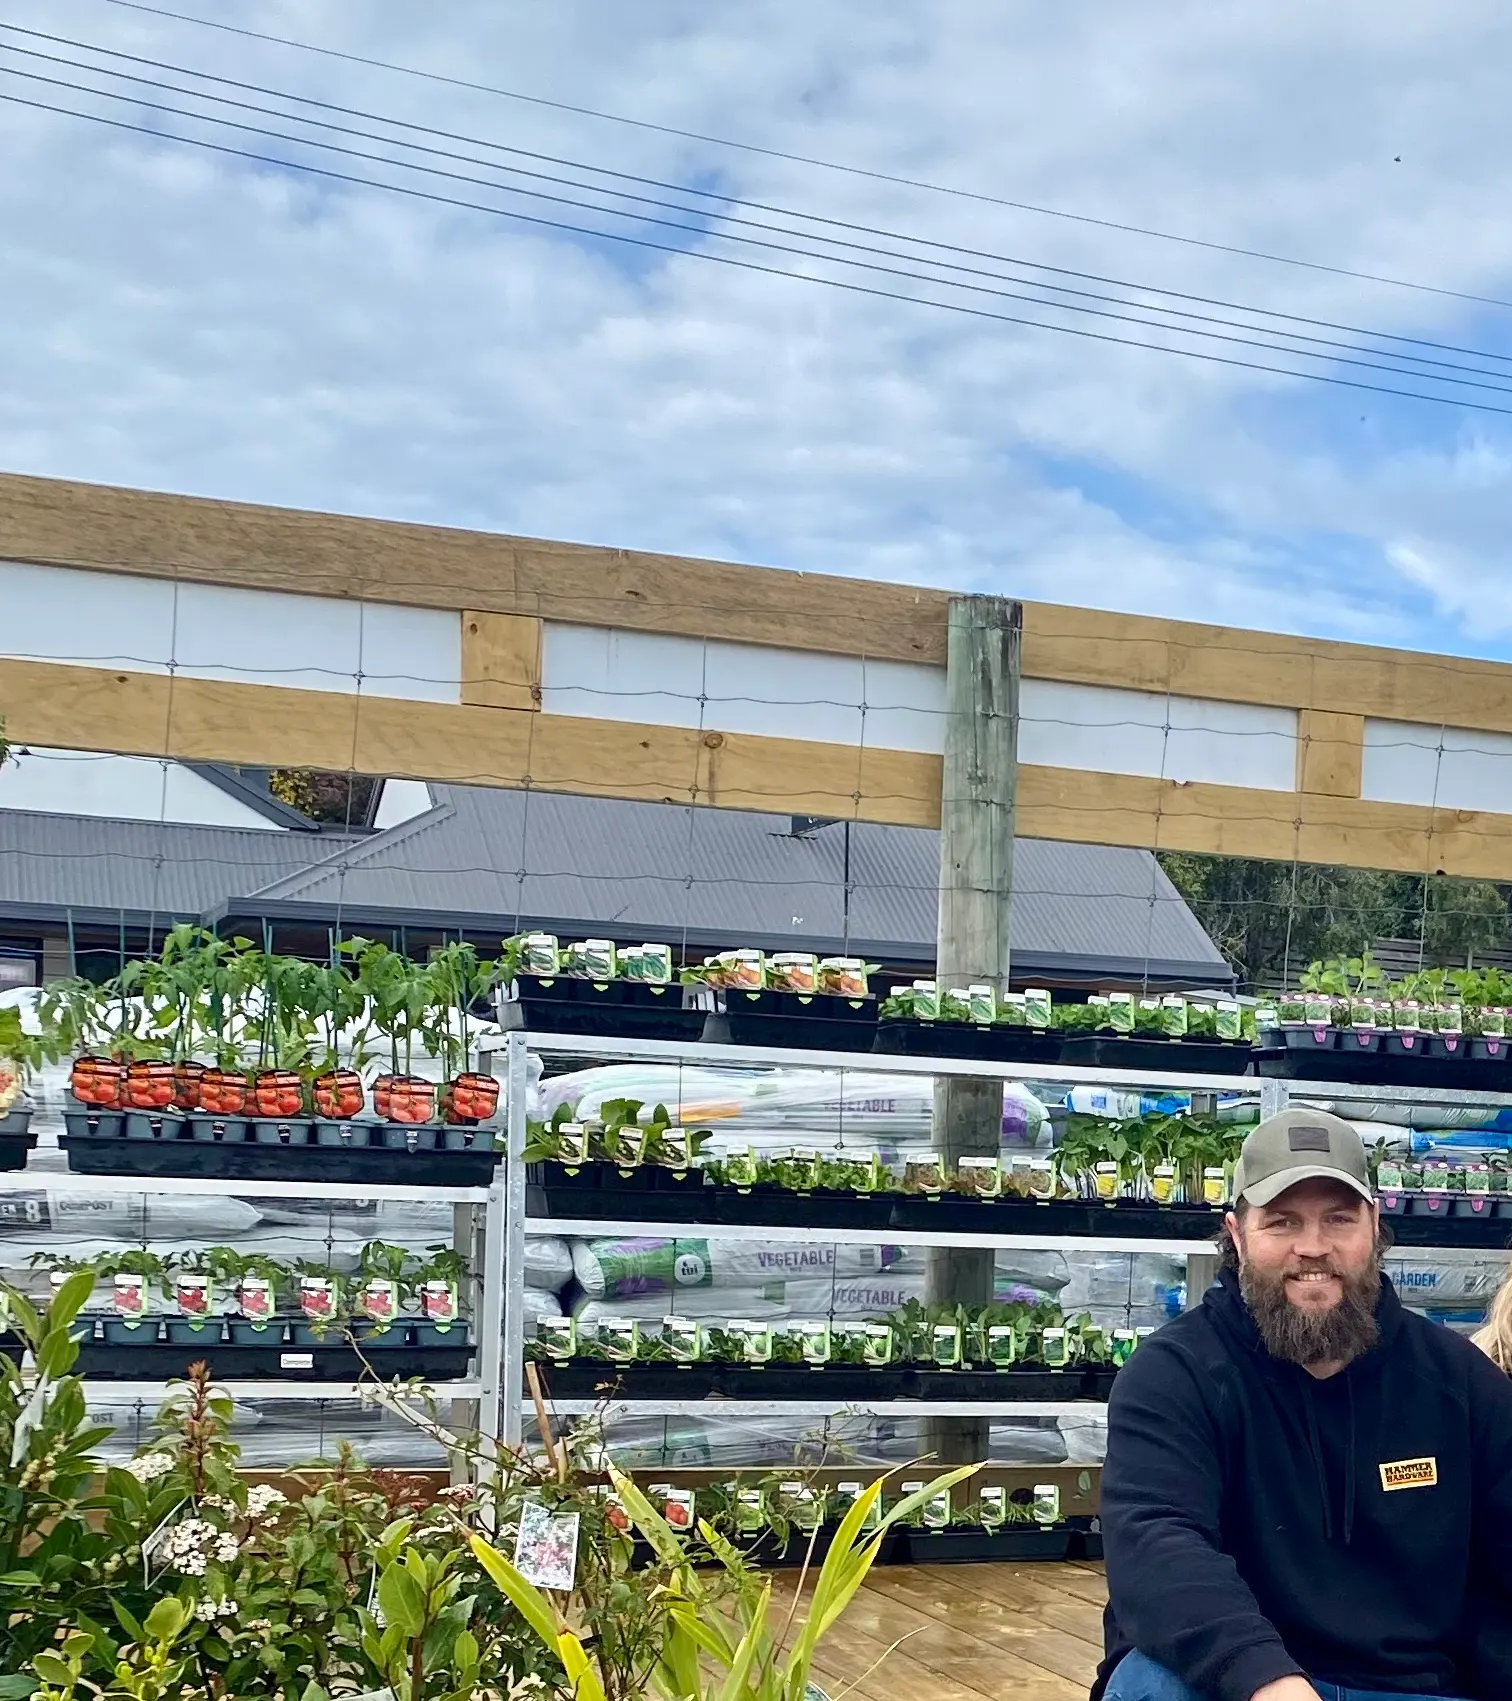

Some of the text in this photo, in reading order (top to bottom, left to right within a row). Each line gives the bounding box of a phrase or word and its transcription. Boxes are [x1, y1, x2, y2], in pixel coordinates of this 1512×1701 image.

[758, 1249, 834, 1267] VEGETABLE
[1392, 1272, 1437, 1287] GARDEN
[834, 1288, 906, 1305] VEGETABLE
[1384, 1462, 1433, 1476] HAMMER
[1386, 1470, 1434, 1483] HARDWARE
